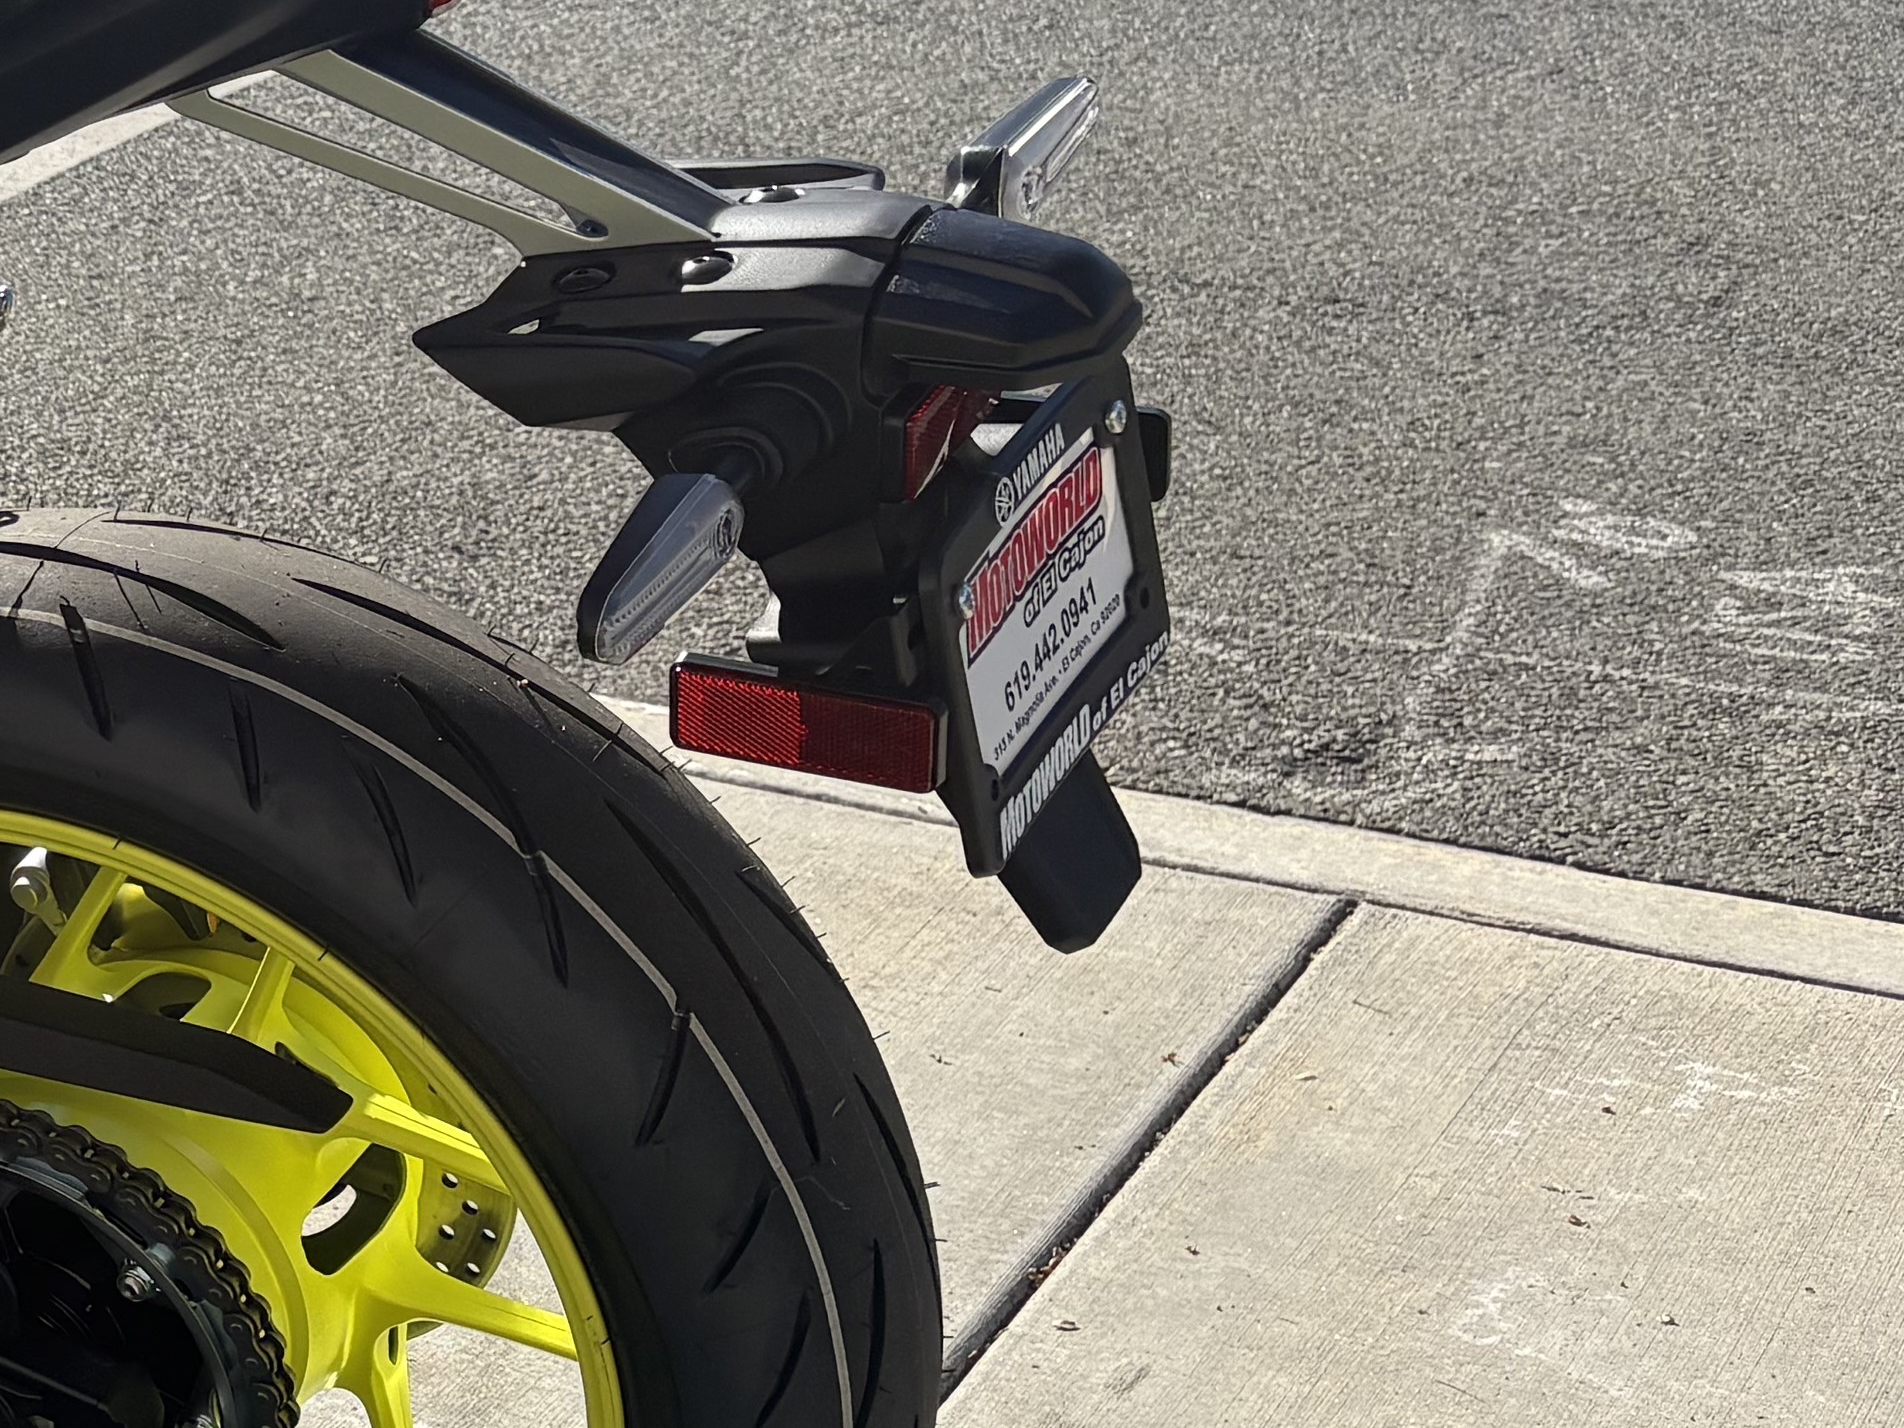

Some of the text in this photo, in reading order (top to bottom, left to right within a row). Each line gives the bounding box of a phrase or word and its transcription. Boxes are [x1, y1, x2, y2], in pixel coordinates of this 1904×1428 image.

[1012, 422, 1066, 501] YAMAHA
[967, 446, 1101, 660] MOTOWORLD
[1023, 514, 1106, 628] of El Cajon
[1004, 576, 1097, 713] 619.442.0941
[999, 630, 1169, 861] MOTOWORLD of El Cajon
